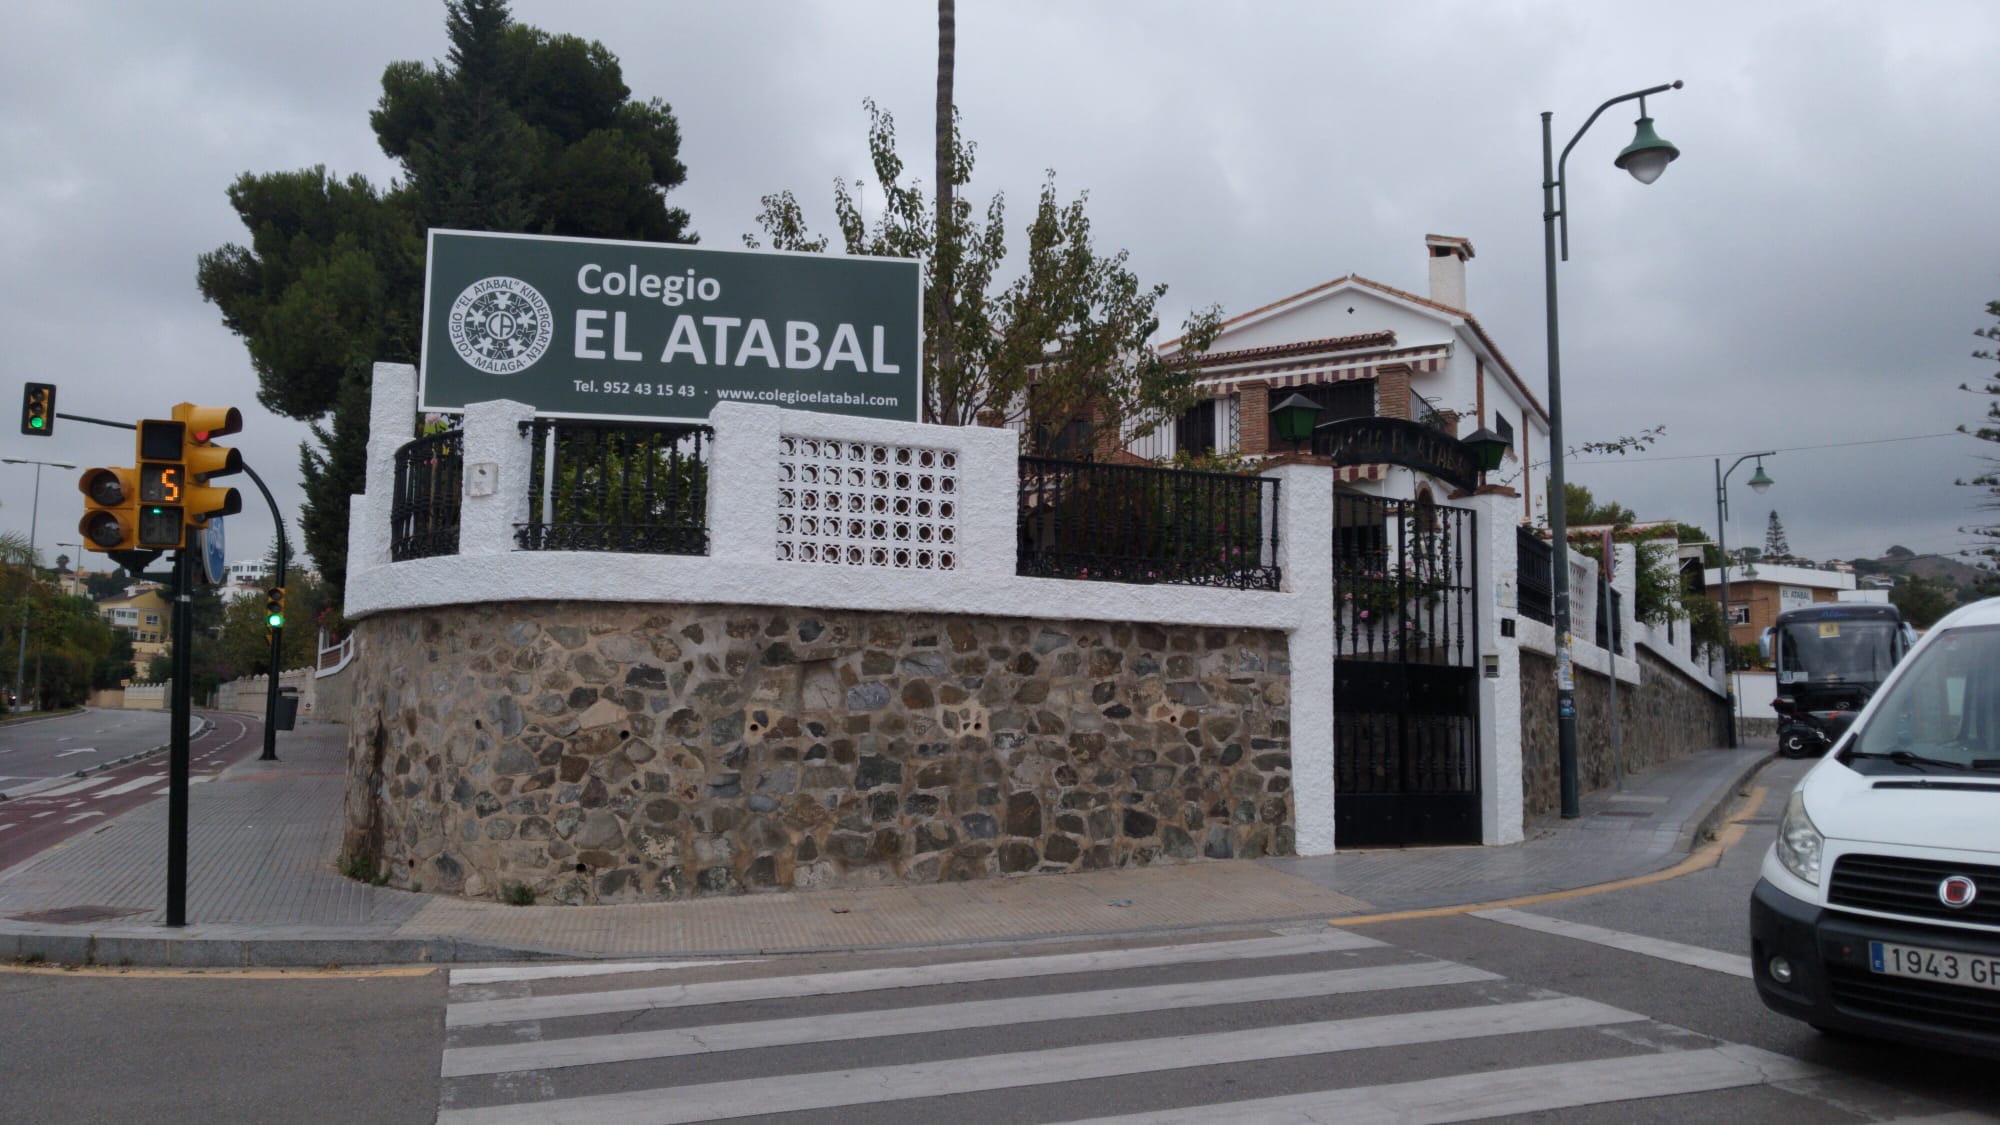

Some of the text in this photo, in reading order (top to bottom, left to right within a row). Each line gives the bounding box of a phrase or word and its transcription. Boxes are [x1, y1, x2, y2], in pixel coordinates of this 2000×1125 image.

[577, 263, 721, 306] Colegio
[452, 312, 473, 358] COLEGIO
[520, 285, 551, 362] KINDERGARTEN
[574, 309, 900, 374] EL ATABAL
[573, 379, 898, 407] Tel. 952 43 15 43 www.colegioelatabal.com
[161, 469, 178, 501] 5
[1892, 948, 1959, 979] 1943
